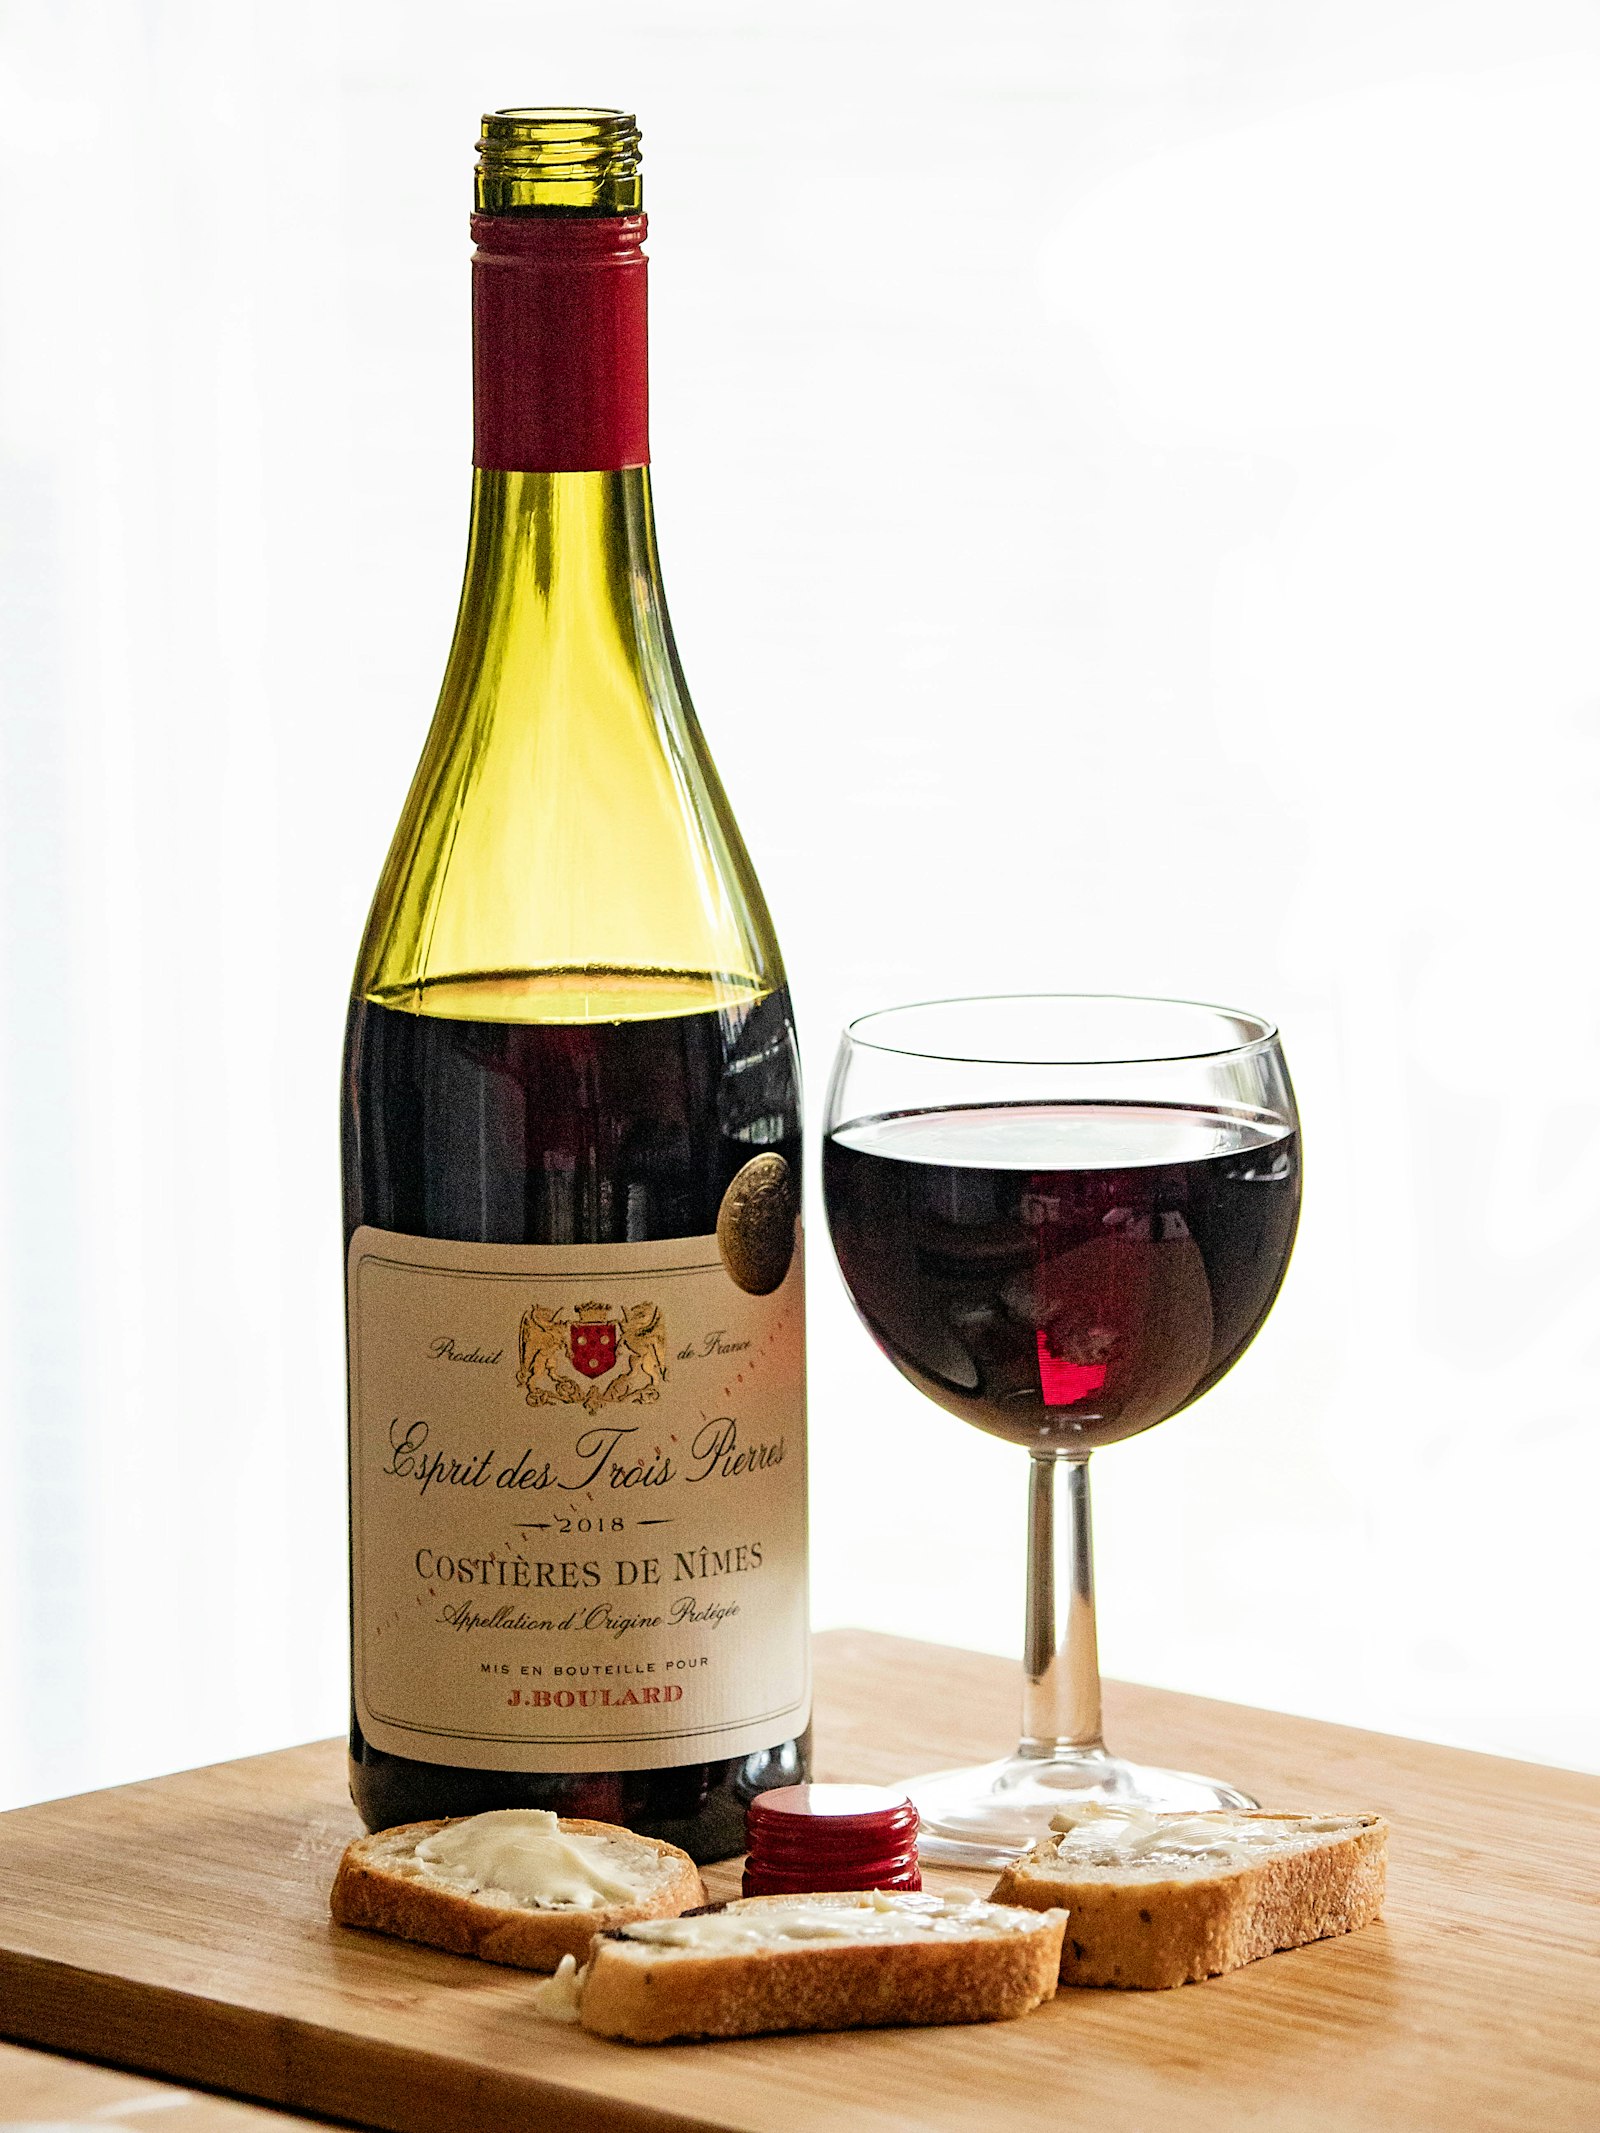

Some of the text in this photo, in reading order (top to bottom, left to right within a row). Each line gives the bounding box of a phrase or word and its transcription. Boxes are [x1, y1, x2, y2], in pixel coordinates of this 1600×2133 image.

[427, 1337, 503, 1365] Produit
[677, 1330, 752, 1360] de France
[383, 1417, 786, 1496] Esprit des Trois Pierres
[559, 1517, 625, 1534] 2018
[415, 1541, 764, 1589] COSTIÈRES DE NÎMES
[435, 1599, 557, 1632] Appellation
[668, 1596, 741, 1629] Protégée
[480, 1656, 710, 1677] MIS EN BOUTEILLE POUR
[507, 1684, 684, 1709] J.BOULARD
